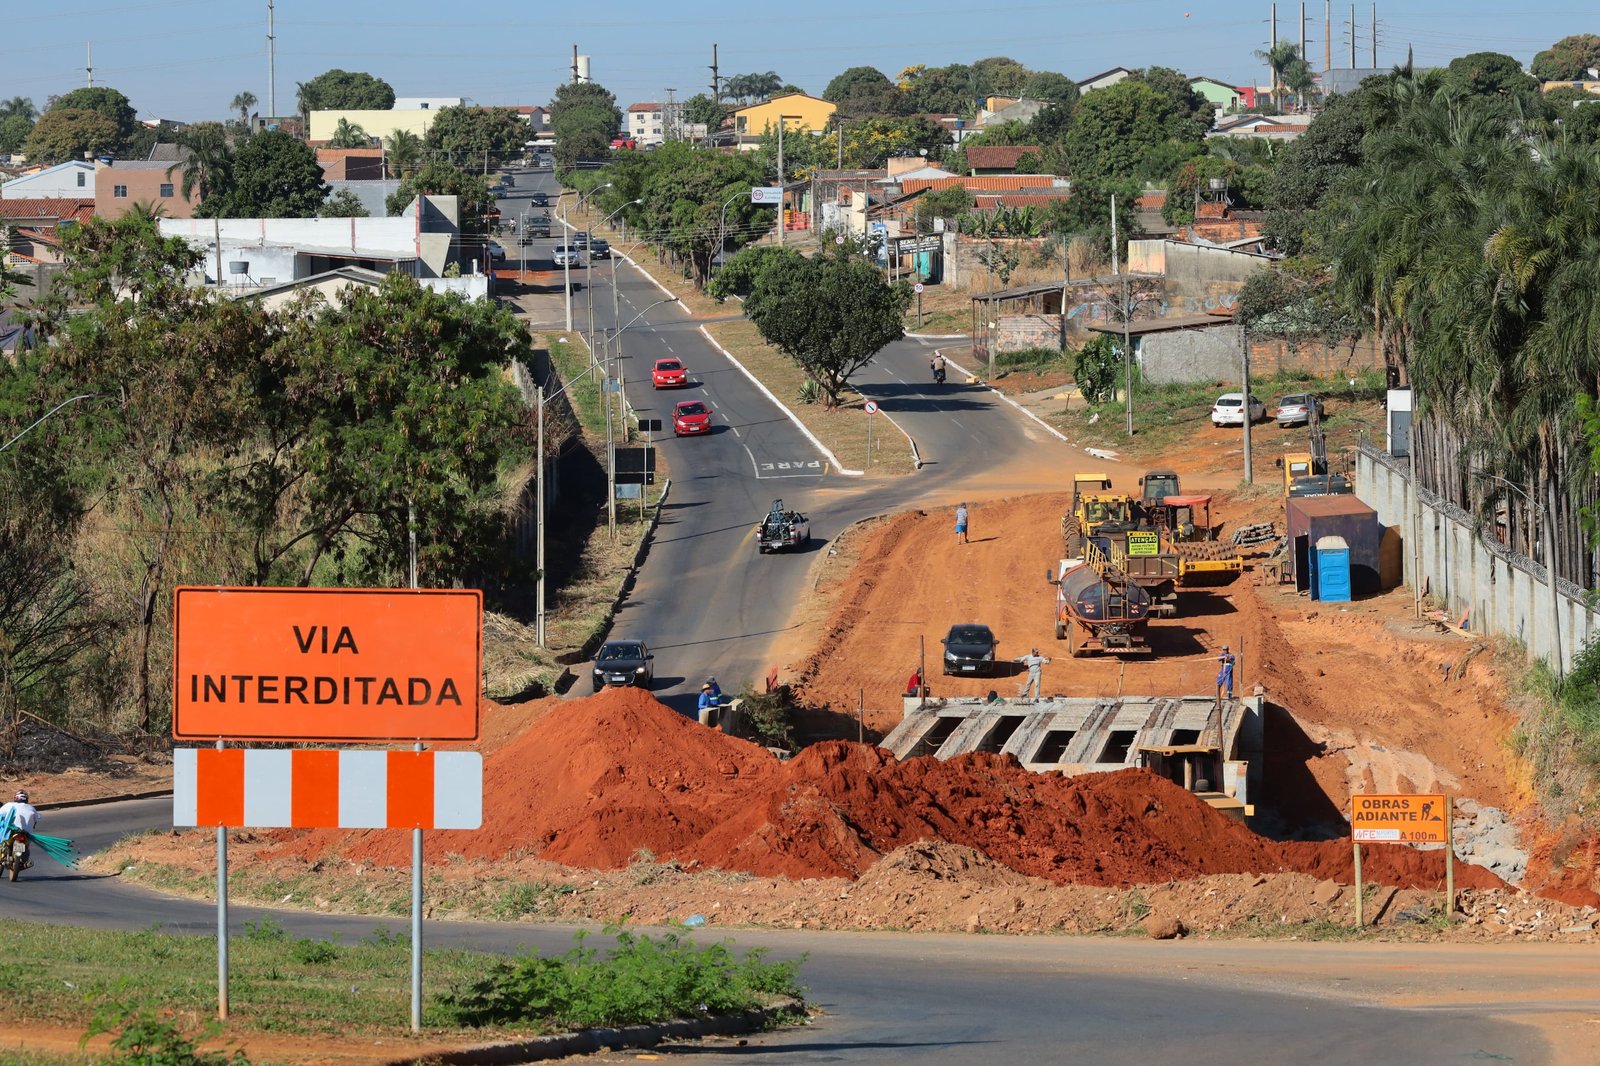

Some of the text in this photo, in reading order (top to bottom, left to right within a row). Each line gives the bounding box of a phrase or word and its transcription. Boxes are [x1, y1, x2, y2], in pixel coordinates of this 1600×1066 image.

[761, 460, 820, 471] PARE
[292, 626, 359, 654] VIA
[191, 674, 462, 705] INTERDITADA
[1362, 799, 1410, 809] OBRAS
[1356, 811, 1417, 821] ADIANTE
